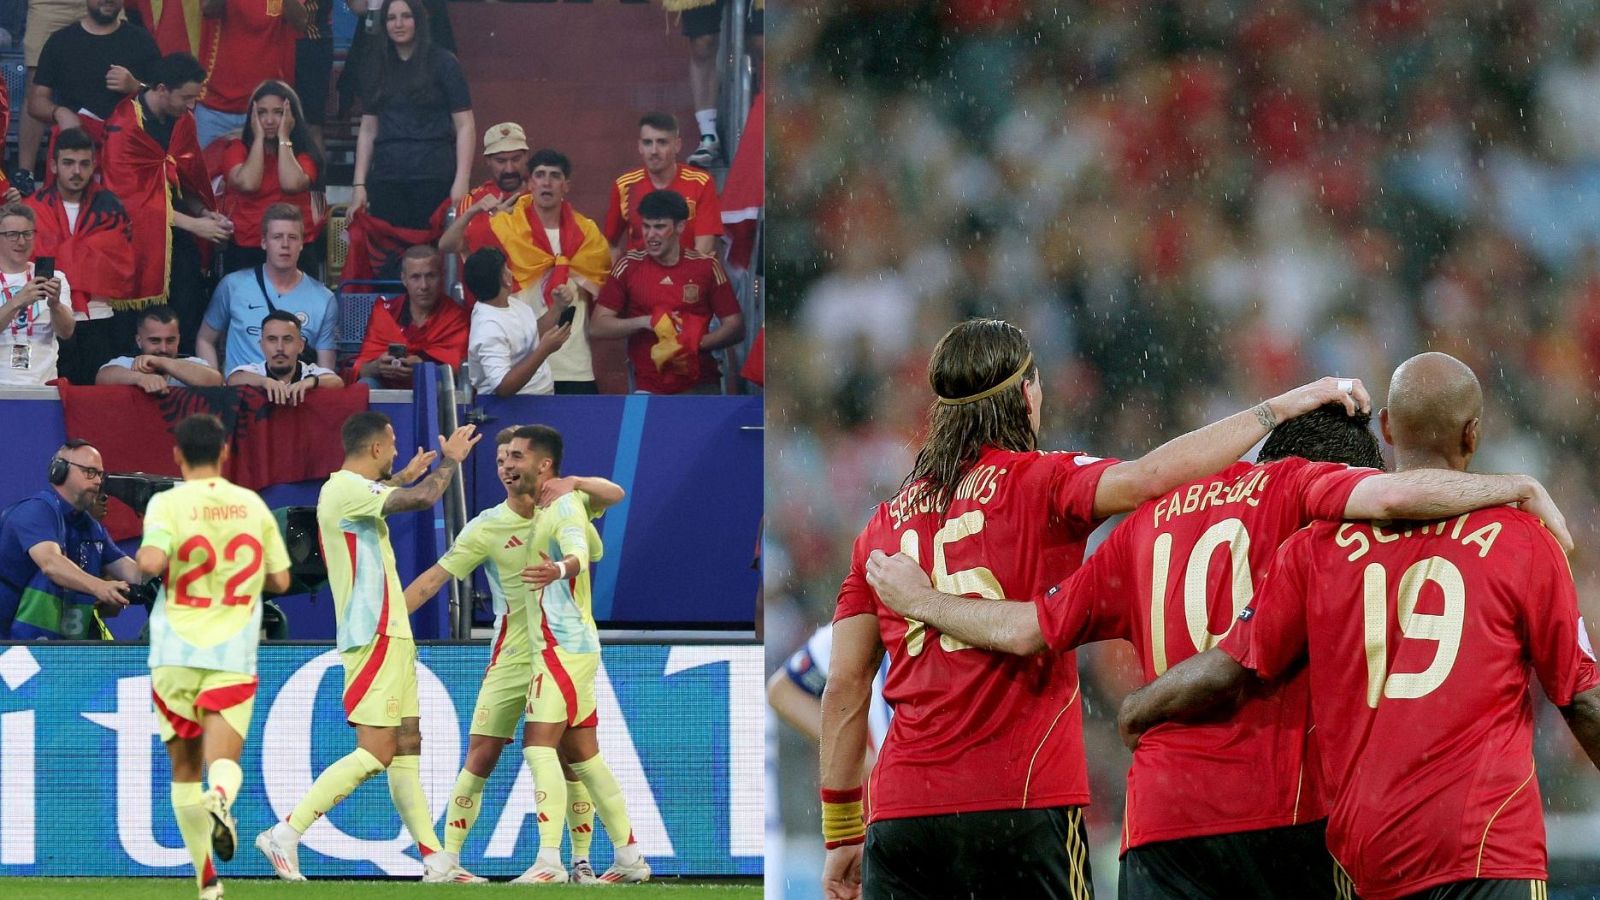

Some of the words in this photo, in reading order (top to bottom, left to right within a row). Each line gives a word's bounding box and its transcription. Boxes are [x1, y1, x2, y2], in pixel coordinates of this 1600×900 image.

[203, 505, 248, 520] NAVAS
[175, 533, 263, 608] 22
[1150, 518, 1254, 677] 10
[1363, 556, 1465, 708] 19
